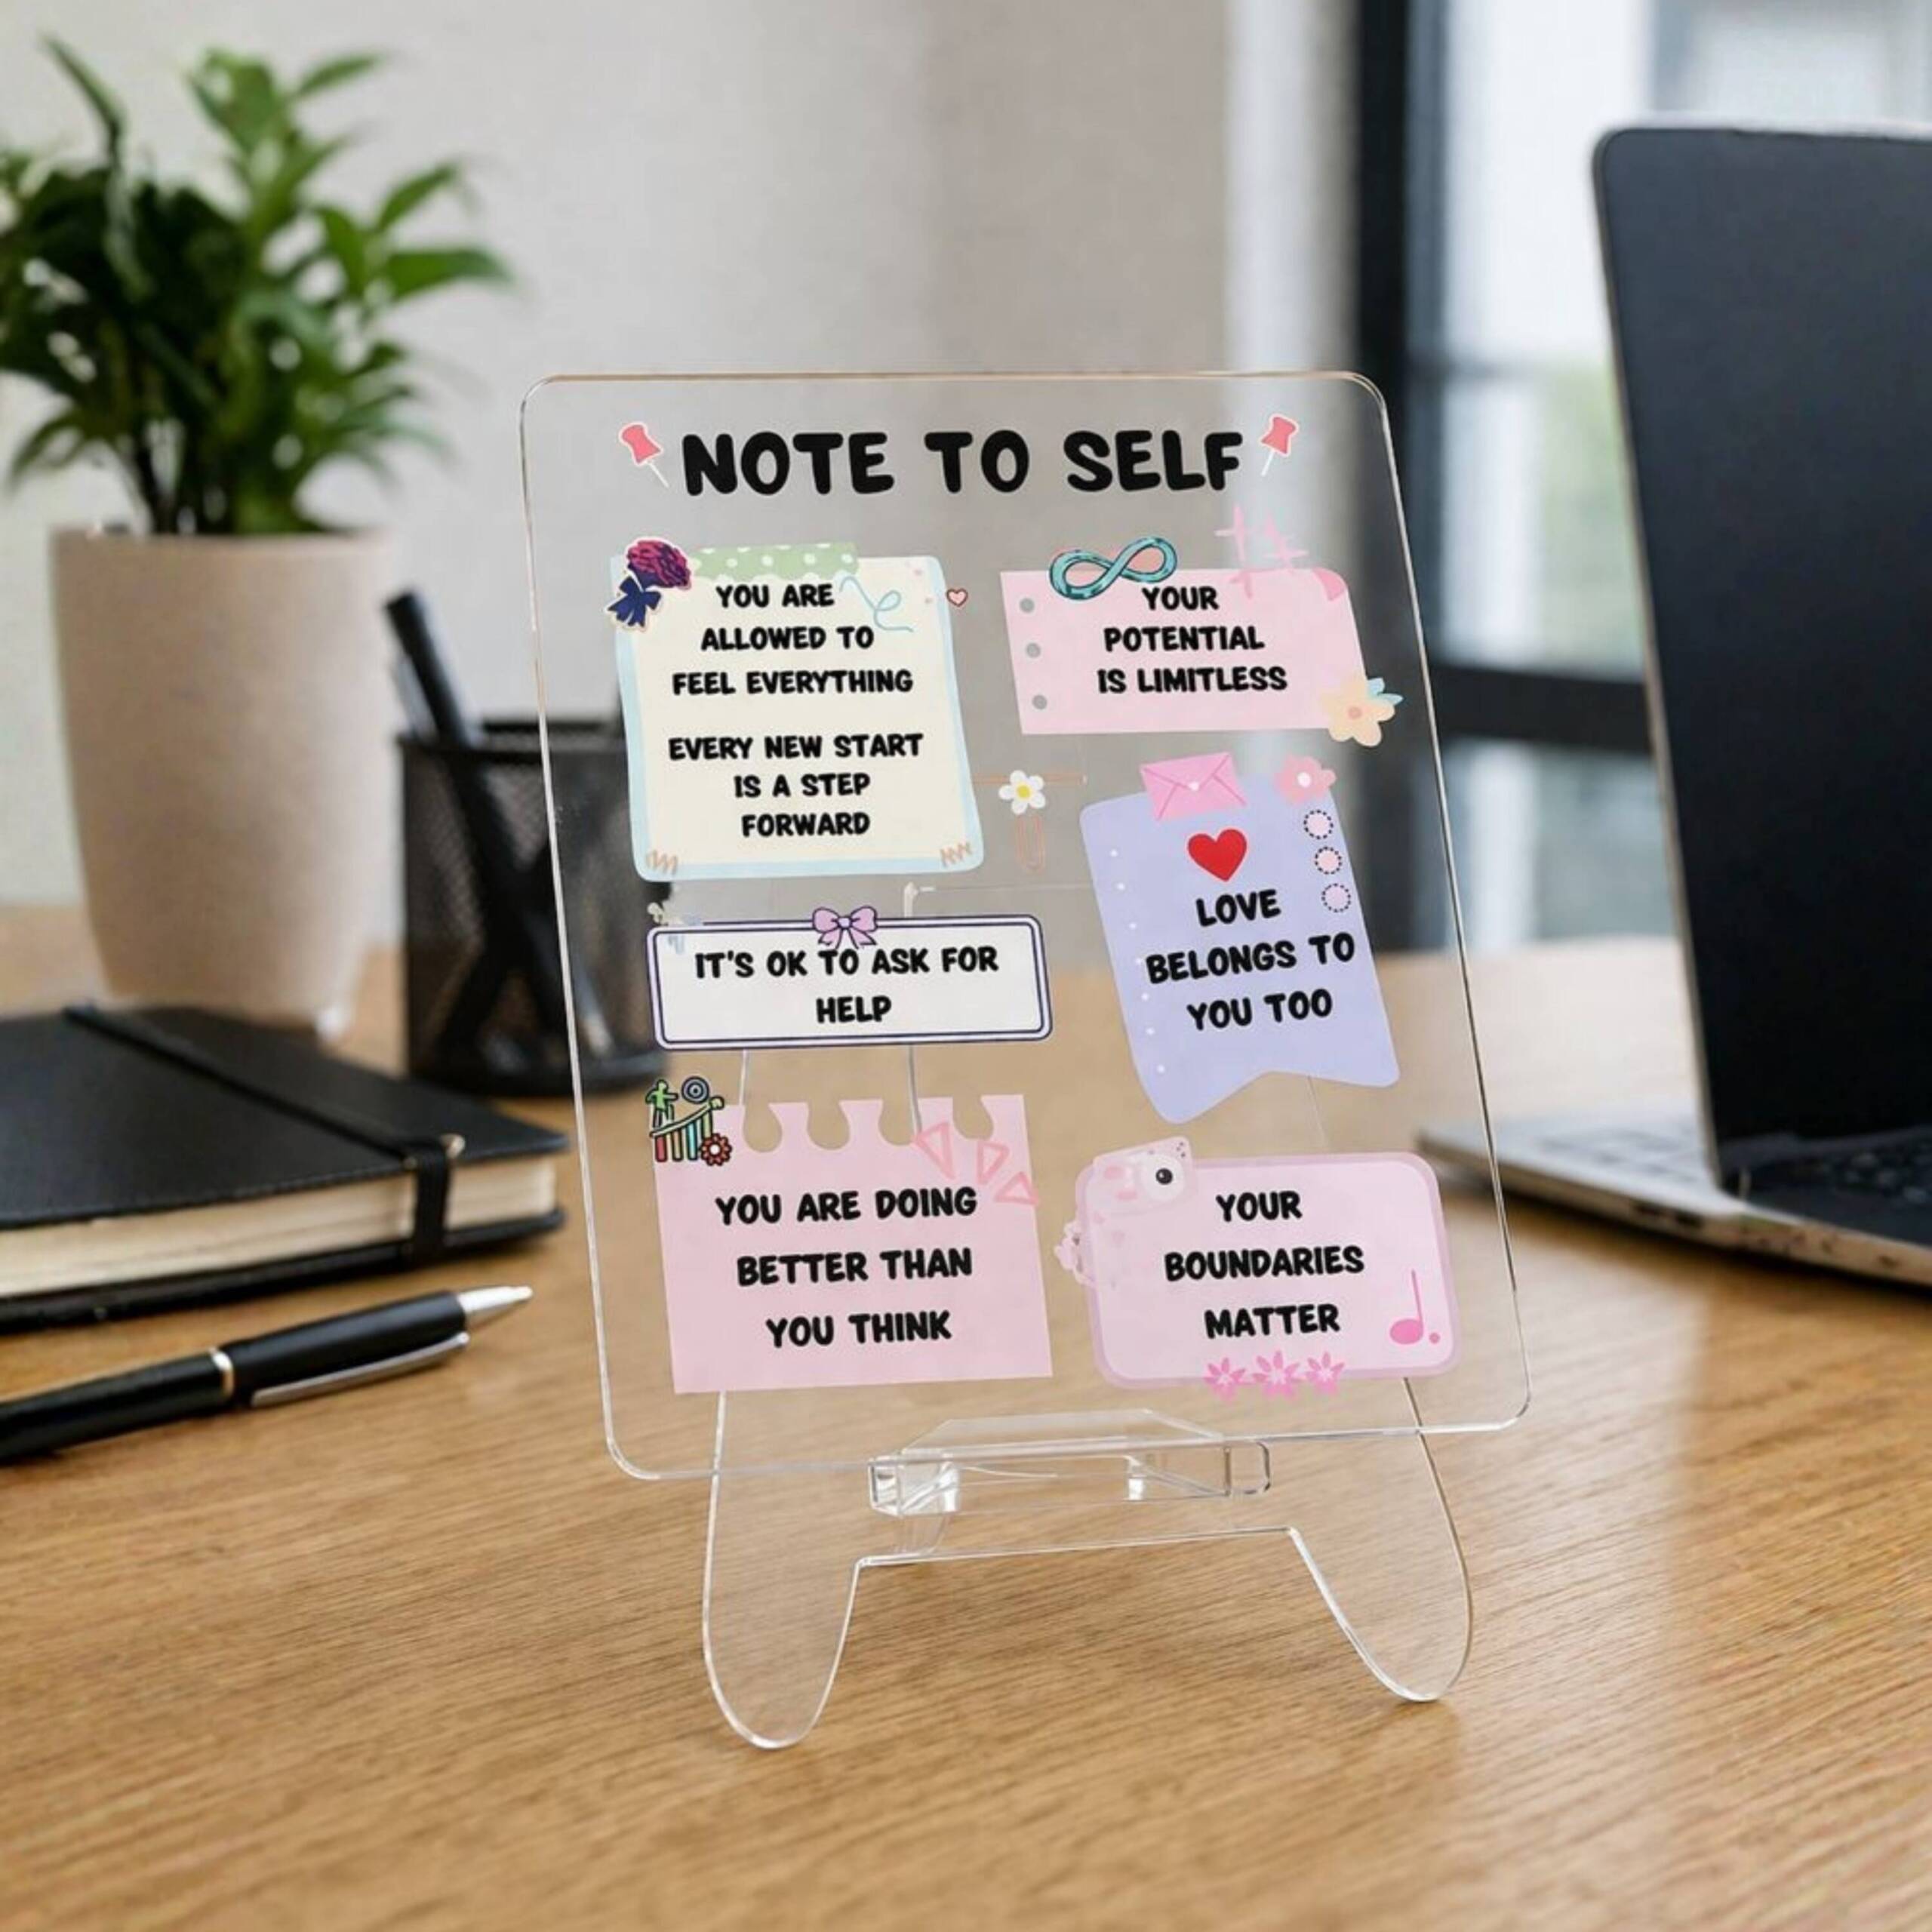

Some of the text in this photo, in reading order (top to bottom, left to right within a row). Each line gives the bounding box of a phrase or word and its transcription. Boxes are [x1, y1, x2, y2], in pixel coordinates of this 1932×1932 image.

[682, 429, 1243, 497] NOTE TO SELF
[715, 583, 835, 608] YOU ARE
[1142, 586, 1219, 611] YOUR
[701, 626, 874, 651] ALLOWED TO
[1103, 626, 1265, 652] POTENTIAL
[672, 669, 913, 695] FEEL EVERYTHING
[1097, 666, 1287, 694] IS LIMITLESS
[669, 733, 923, 761] EVERY NEW START
[734, 773, 870, 798] IS A STEP
[742, 812, 870, 837] FORWARD
[1195, 889, 1281, 927] LOVE
[695, 946, 998, 979] IT'S OK TO ASK FOR
[1146, 932, 1355, 984] BELONGS TO
[816, 995, 891, 1023] HELP
[1186, 989, 1332, 1031] YOU TOO
[715, 1186, 977, 1226] YOU ARE DOING
[1216, 1190, 1303, 1222] YOUR
[737, 1247, 972, 1287] BETTER THAN
[1164, 1245, 1364, 1281] BOUNDARIES
[766, 1310, 952, 1348] YOU THINK
[1204, 1303, 1340, 1339] MATTER
